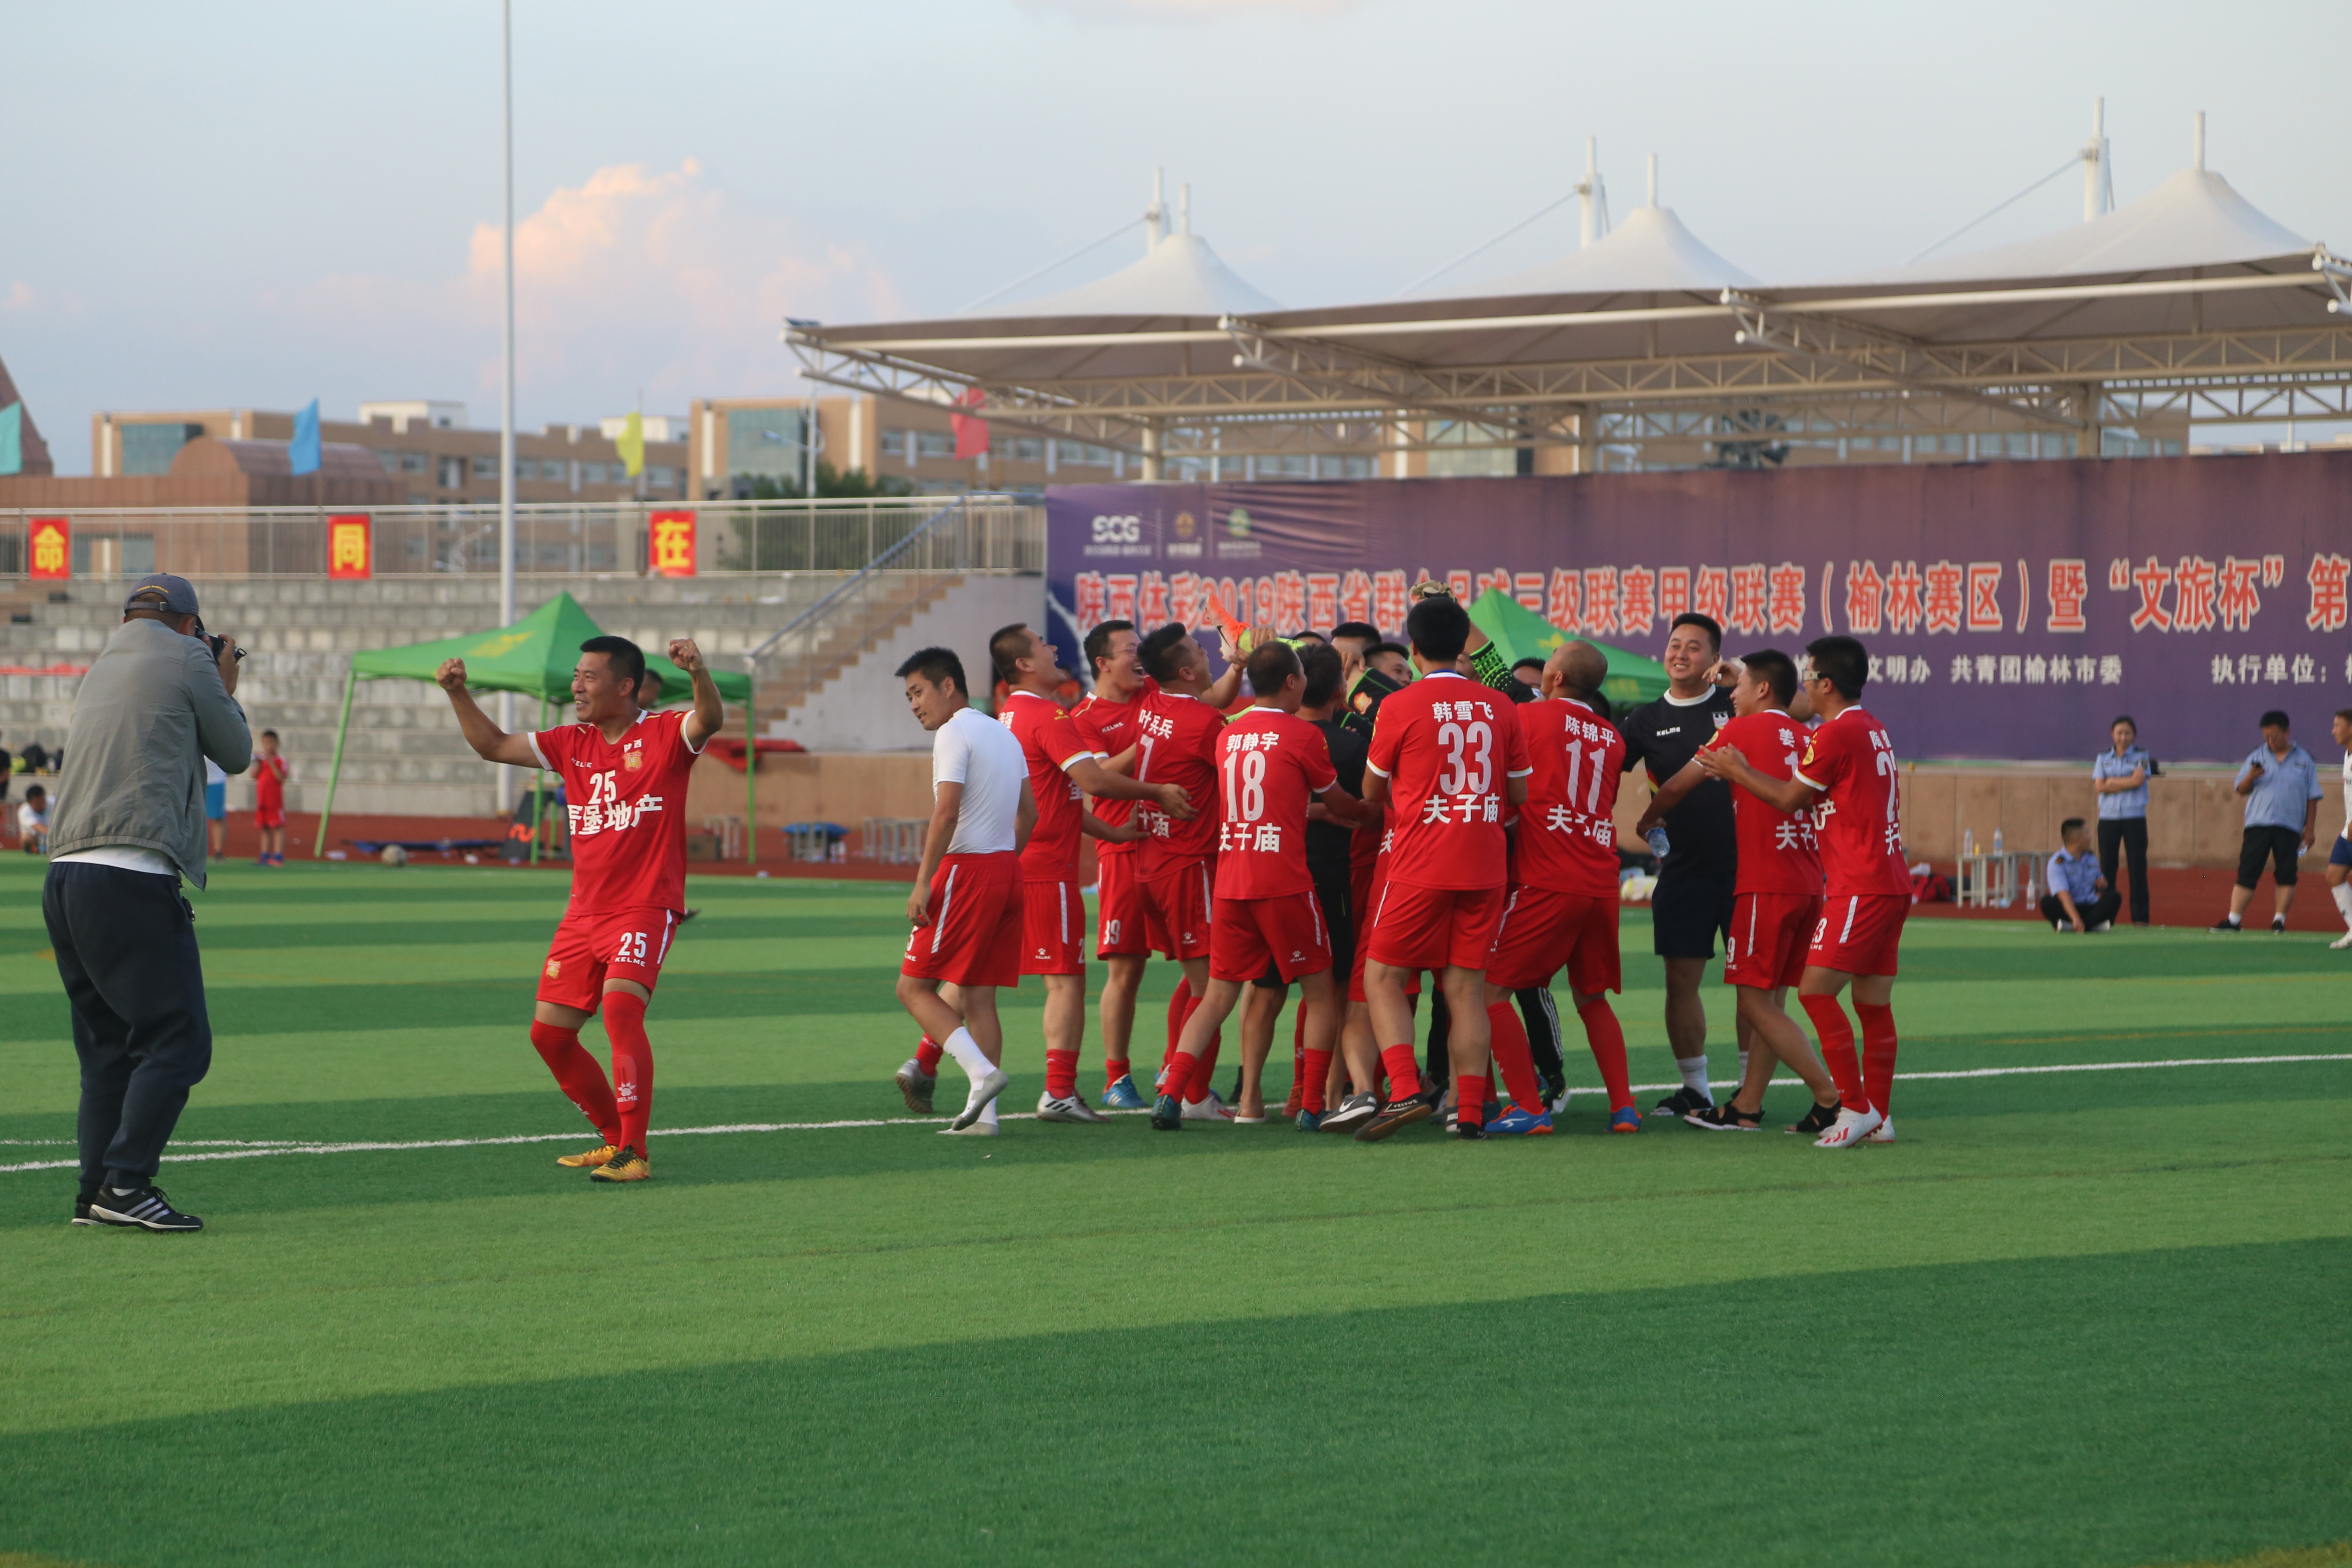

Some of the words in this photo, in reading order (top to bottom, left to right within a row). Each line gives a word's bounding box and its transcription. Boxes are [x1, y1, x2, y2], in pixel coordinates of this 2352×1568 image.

[34, 524, 65, 573] 命
[333, 523, 365, 571] 同
[654, 518, 690, 568] 在
[1951, 653, 2122, 685] 共青团榆林市委
[2211, 652, 2352, 685] 执行单位：
[1432, 700, 1494, 723] 韩雪飞
[1102, 722, 1124, 733] KELME
[1226, 731, 1280, 753] 郭静宇
[1565, 714, 1616, 747] 陈锦平
[1657, 726, 1681, 736] KELME
[623, 738, 643, 753] 陕西
[1438, 721, 1493, 795] 33
[571, 757, 592, 768] KELE
[1565, 738, 1606, 814] 11
[588, 769, 617, 805] 25
[1224, 750, 1266, 823] 18
[1422, 793, 1501, 824] 夫子庙
[1219, 822, 1282, 853] 夫子庙
[1776, 821, 1819, 851] 夫子
[618, 932, 647, 959] 25
[615, 957, 646, 968] KELME
[617, 1095, 638, 1103] KELME
